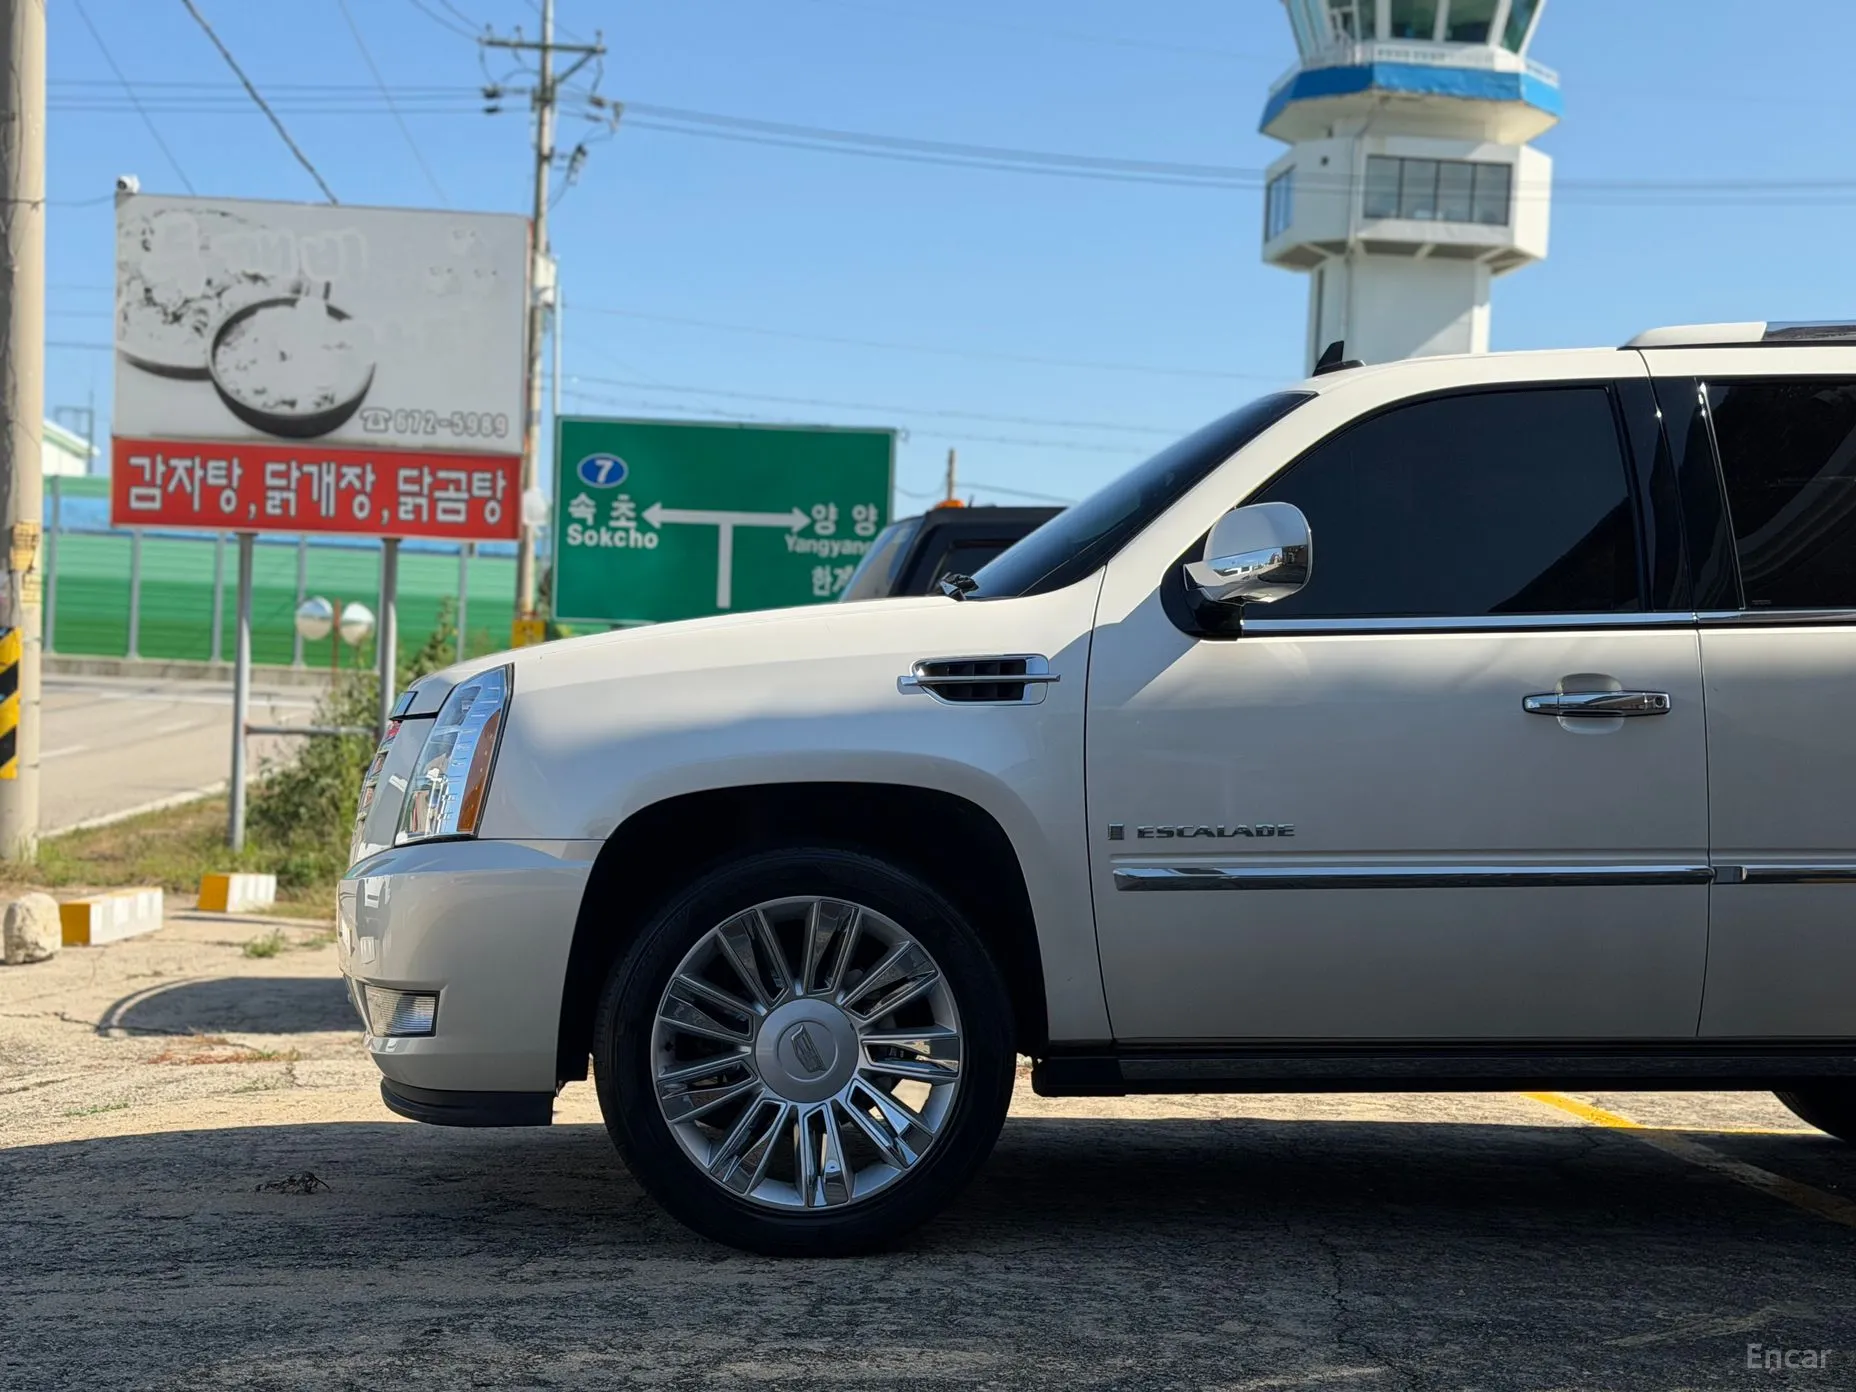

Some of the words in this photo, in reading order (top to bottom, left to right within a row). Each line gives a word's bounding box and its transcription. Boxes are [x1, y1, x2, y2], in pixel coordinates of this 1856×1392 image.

[595, 459, 613, 484] 7
[566, 524, 659, 549] Sokcho
[1137, 823, 1296, 839] ESCALADE
